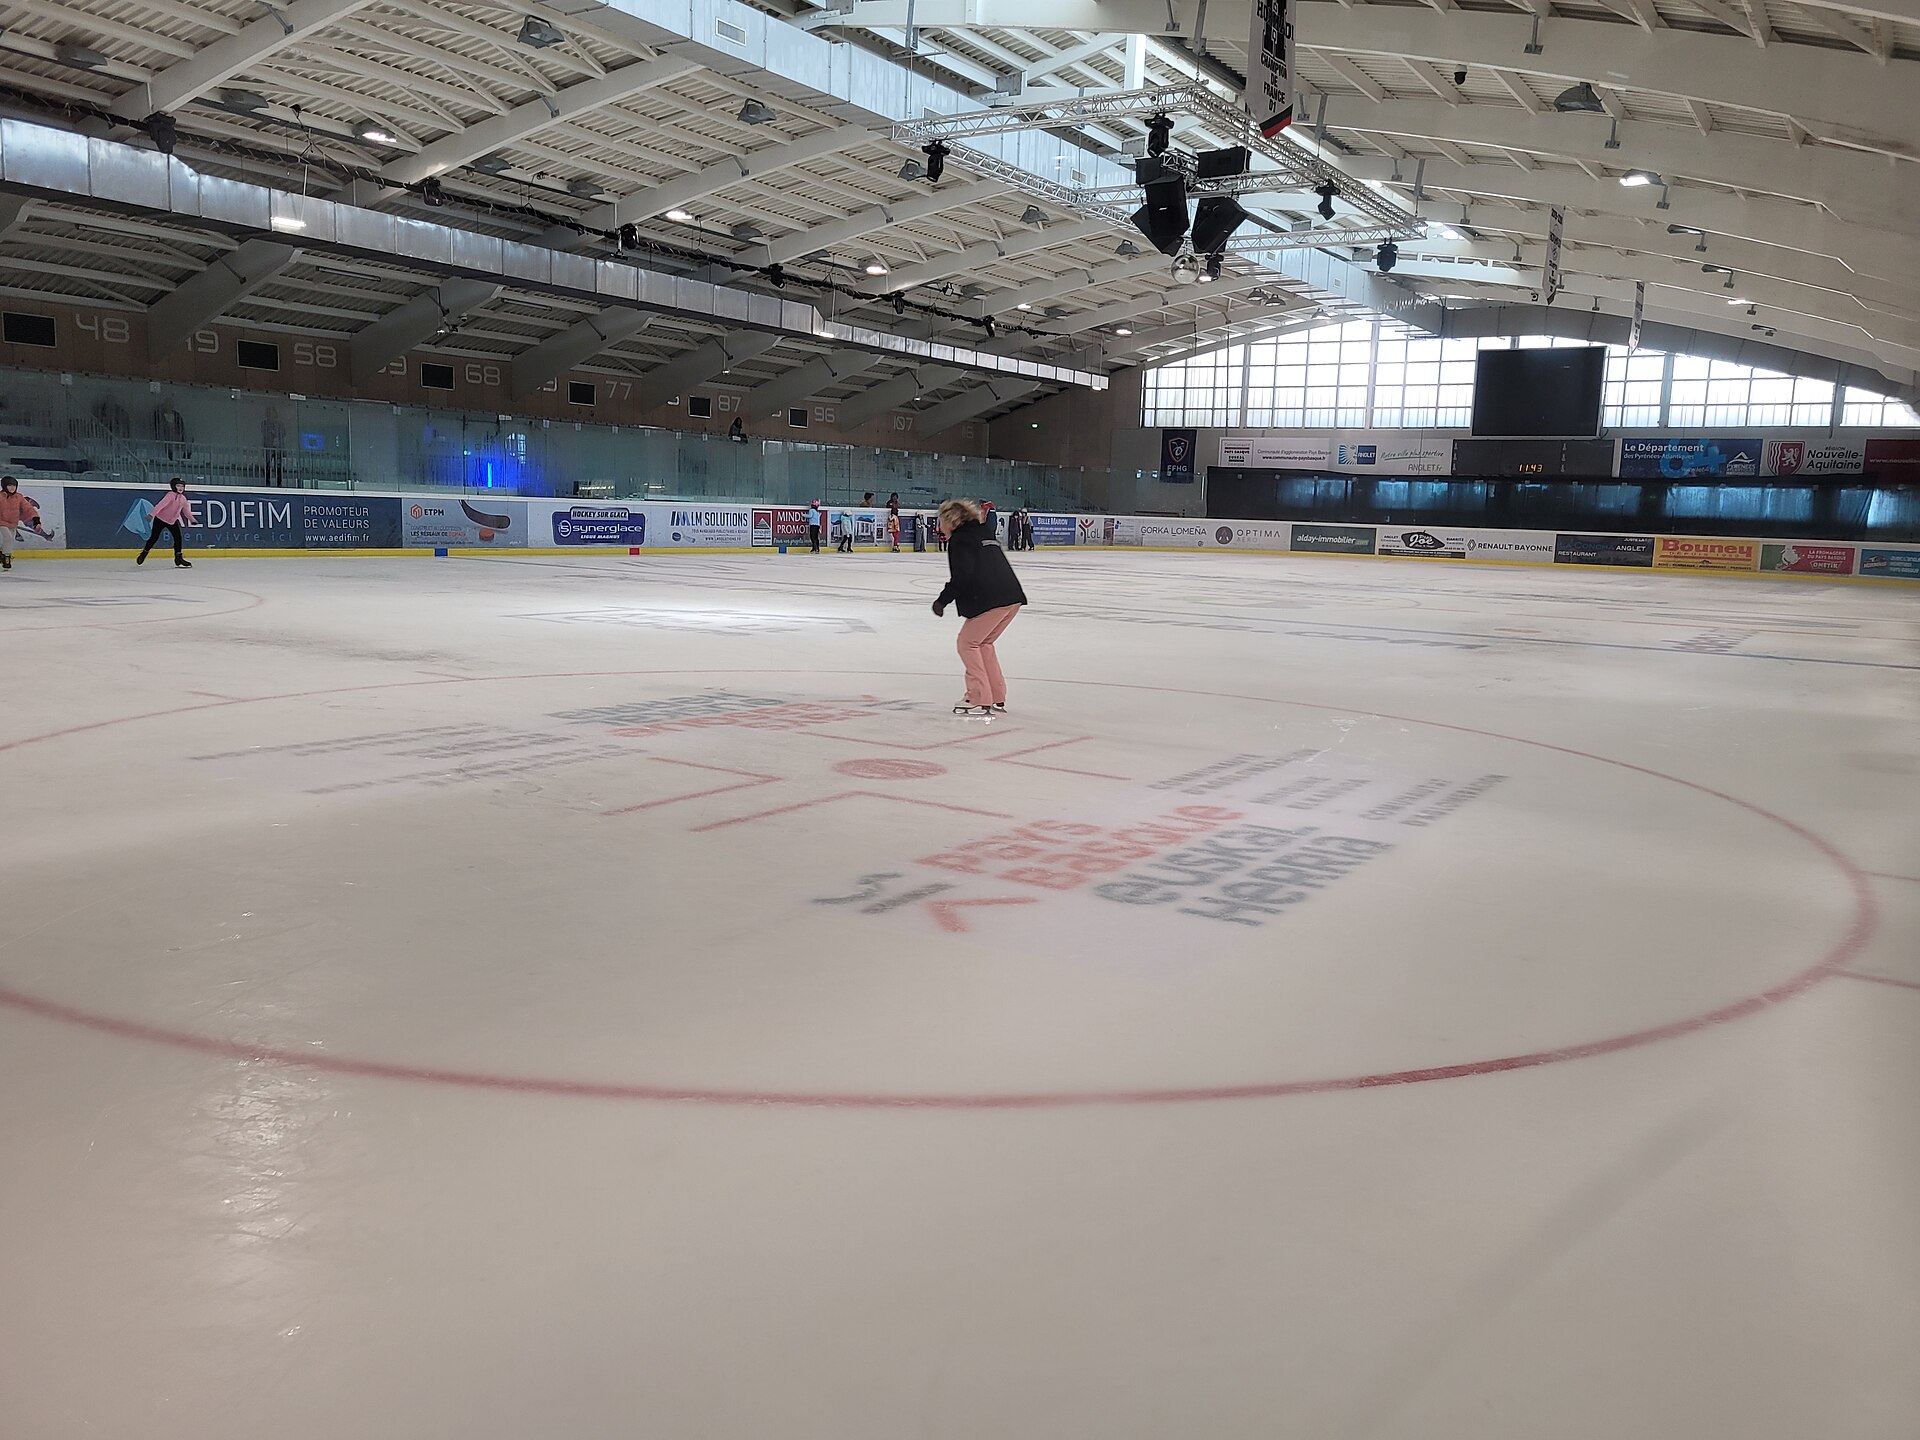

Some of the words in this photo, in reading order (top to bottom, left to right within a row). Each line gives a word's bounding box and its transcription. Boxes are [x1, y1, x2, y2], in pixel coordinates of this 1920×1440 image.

[1270, 73, 1278, 88] DE
[1264, 81, 1286, 104] FRANCE
[75, 313, 130, 343] 48
[294, 343, 337, 368] 58
[465, 363, 500, 386] 68
[605, 380, 633, 400] 77
[718, 395, 742, 413] 87
[814, 407, 835, 423] 96
[893, 416, 914, 432] 107
[1624, 444, 1636, 452] Le
[1638, 443, 1704, 453] Département
[1807, 450, 1863, 459] Nouvelle-
[1806, 460, 1861, 471] Aquitaine
[178, 500, 292, 528] EDIFIM
[304, 506, 369, 516] PROMOTEUR
[424, 508, 444, 516] ETPM
[572, 510, 596, 518] HOCKEY
[691, 512, 702, 526] LM
[704, 512, 748, 526] SOLUTIONS
[777, 512, 822, 522] MINDU
[304, 519, 318, 528] DE
[322, 519, 370, 528] VALEURS
[572, 524, 642, 533] synerglace
[777, 524, 822, 534] PROMOTN
[1141, 526, 1170, 535] GORKA
[1237, 529, 1280, 538] OPTIMA
[163, 532, 203, 541] Ben
[216, 532, 260, 542] vivre
[272, 532, 292, 542] ici
[305, 534, 370, 542] www.aedifim.fr
[1410, 534, 1434, 547] Joe
[1662, 539, 1752, 558] Bouney
